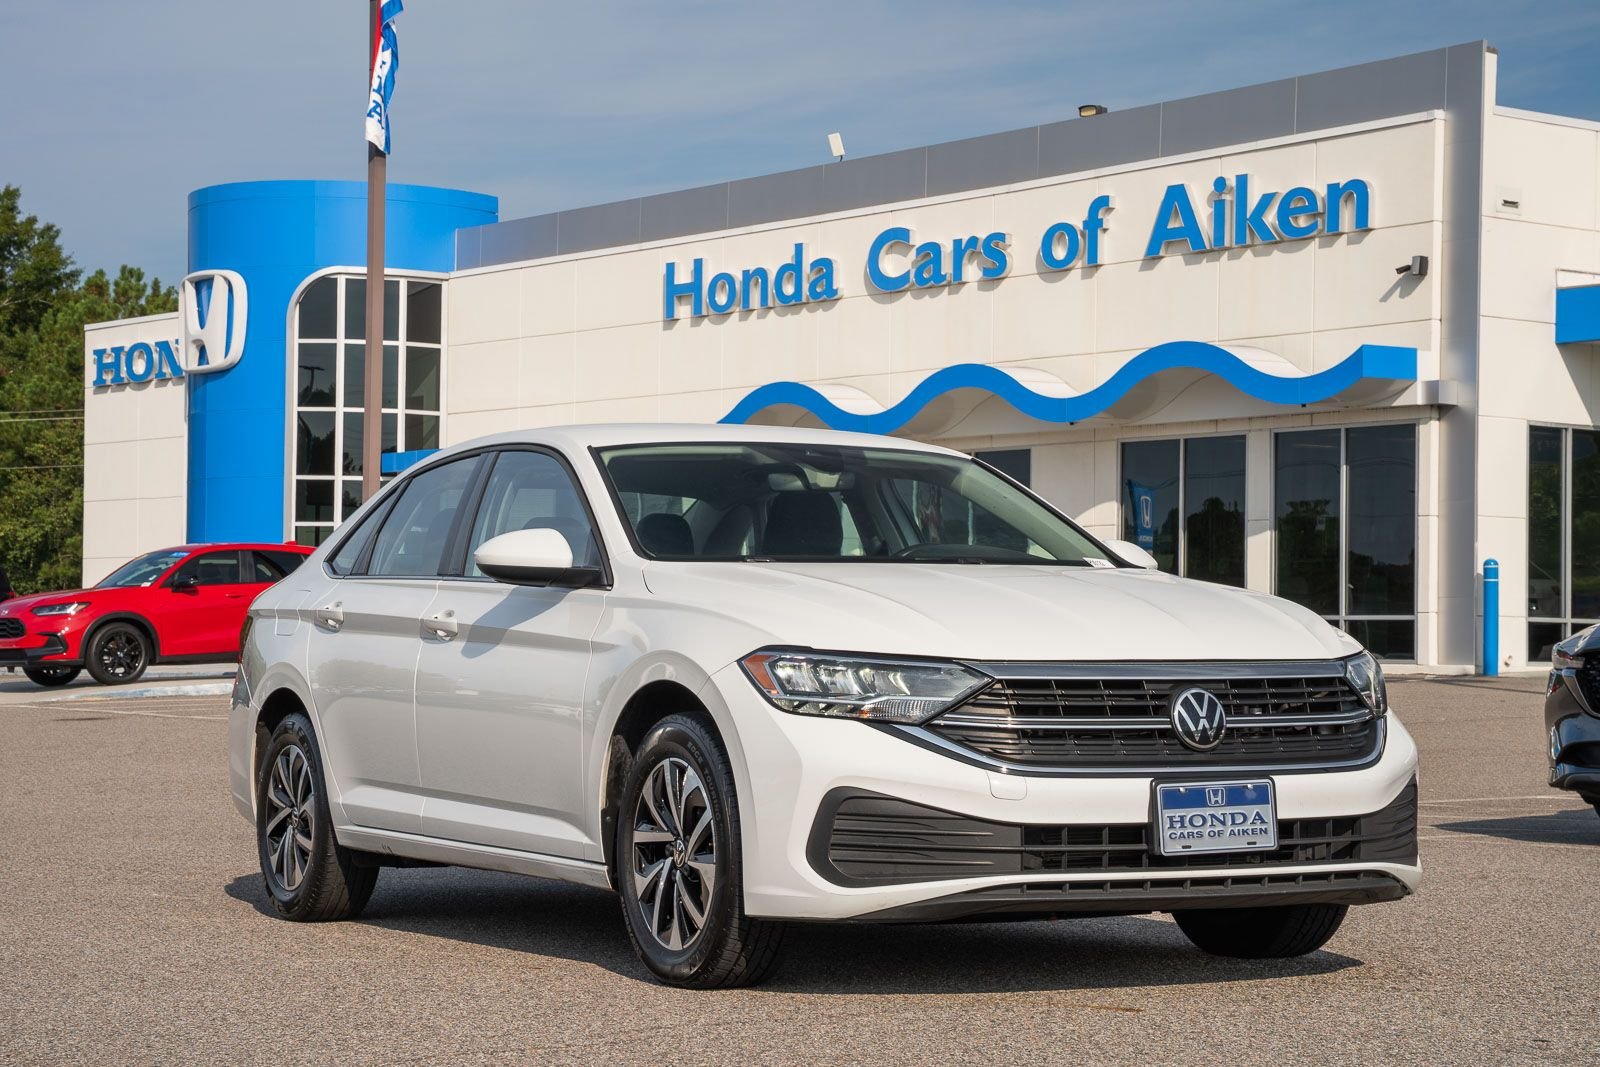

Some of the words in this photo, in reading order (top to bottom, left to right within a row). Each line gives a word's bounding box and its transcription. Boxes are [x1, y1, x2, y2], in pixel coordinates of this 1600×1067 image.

[665, 242, 839, 321] Honda
[867, 226, 1008, 292] Cars
[1040, 195, 1110, 270] of
[1144, 173, 1370, 258] Aiken
[1166, 810, 1268, 830] HONDA
[1168, 831, 1204, 841] CARS
[1207, 829, 1225, 838] OF
[1228, 827, 1268, 837] AIKEN
